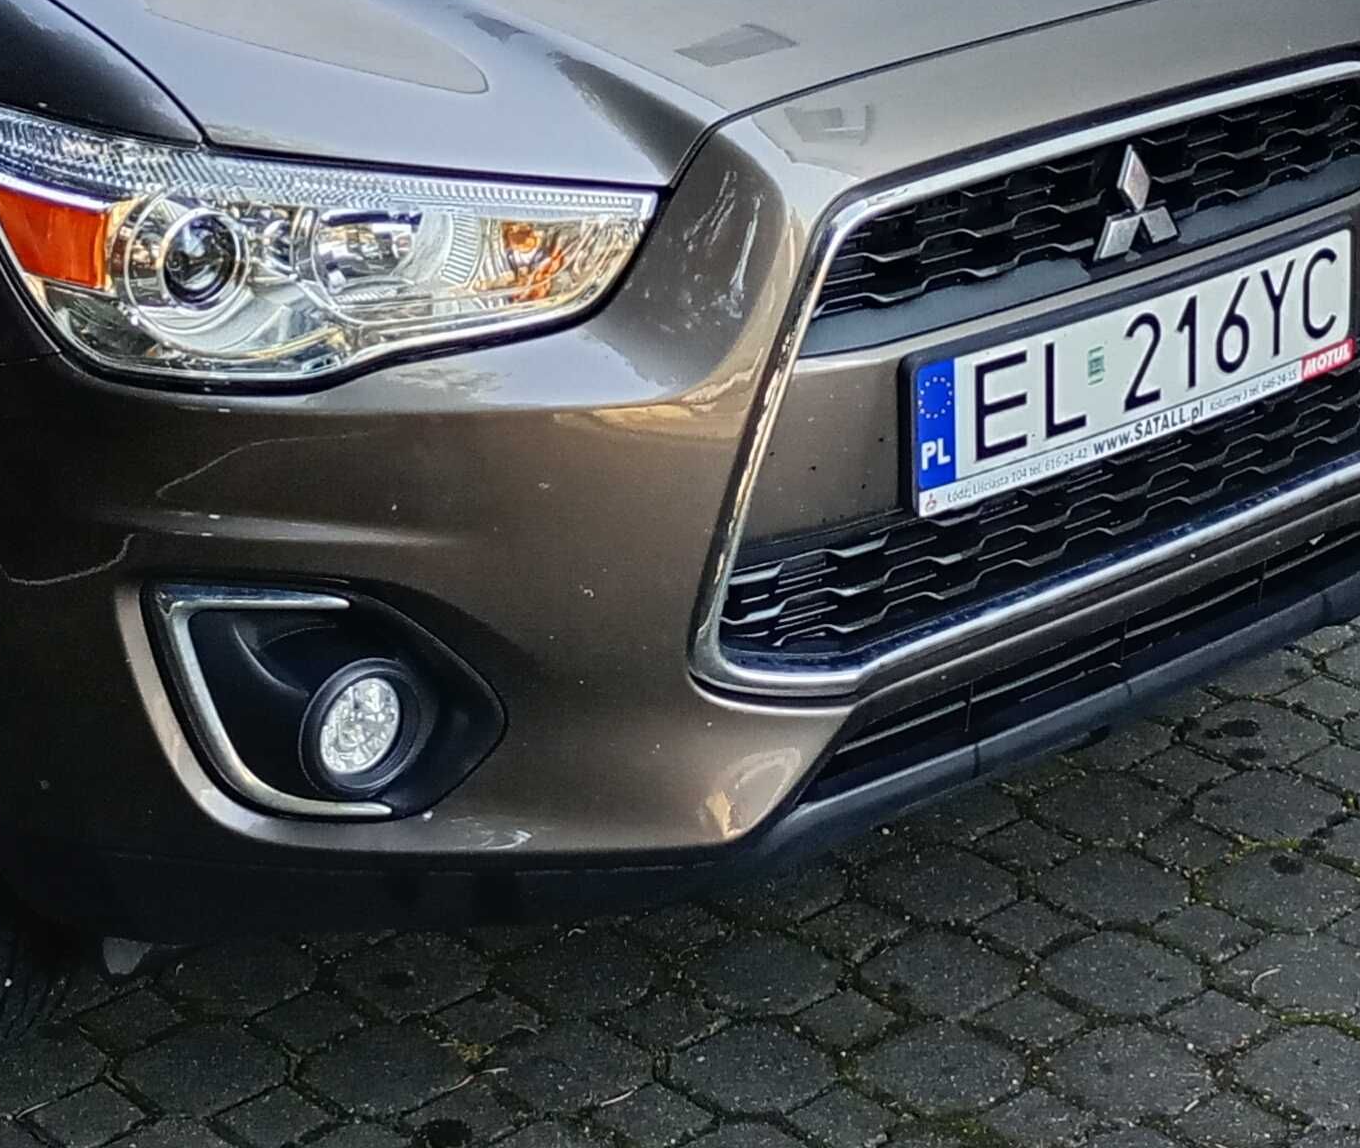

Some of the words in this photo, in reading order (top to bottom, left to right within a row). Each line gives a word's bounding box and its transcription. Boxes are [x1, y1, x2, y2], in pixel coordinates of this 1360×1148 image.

[975, 343, 1086, 462] EL
[1123, 247, 1337, 413] 216YC
[1303, 342, 1351, 379] MOTUL
[1093, 400, 1204, 455] www.SATALL.pl
[921, 438, 951, 471] PL
